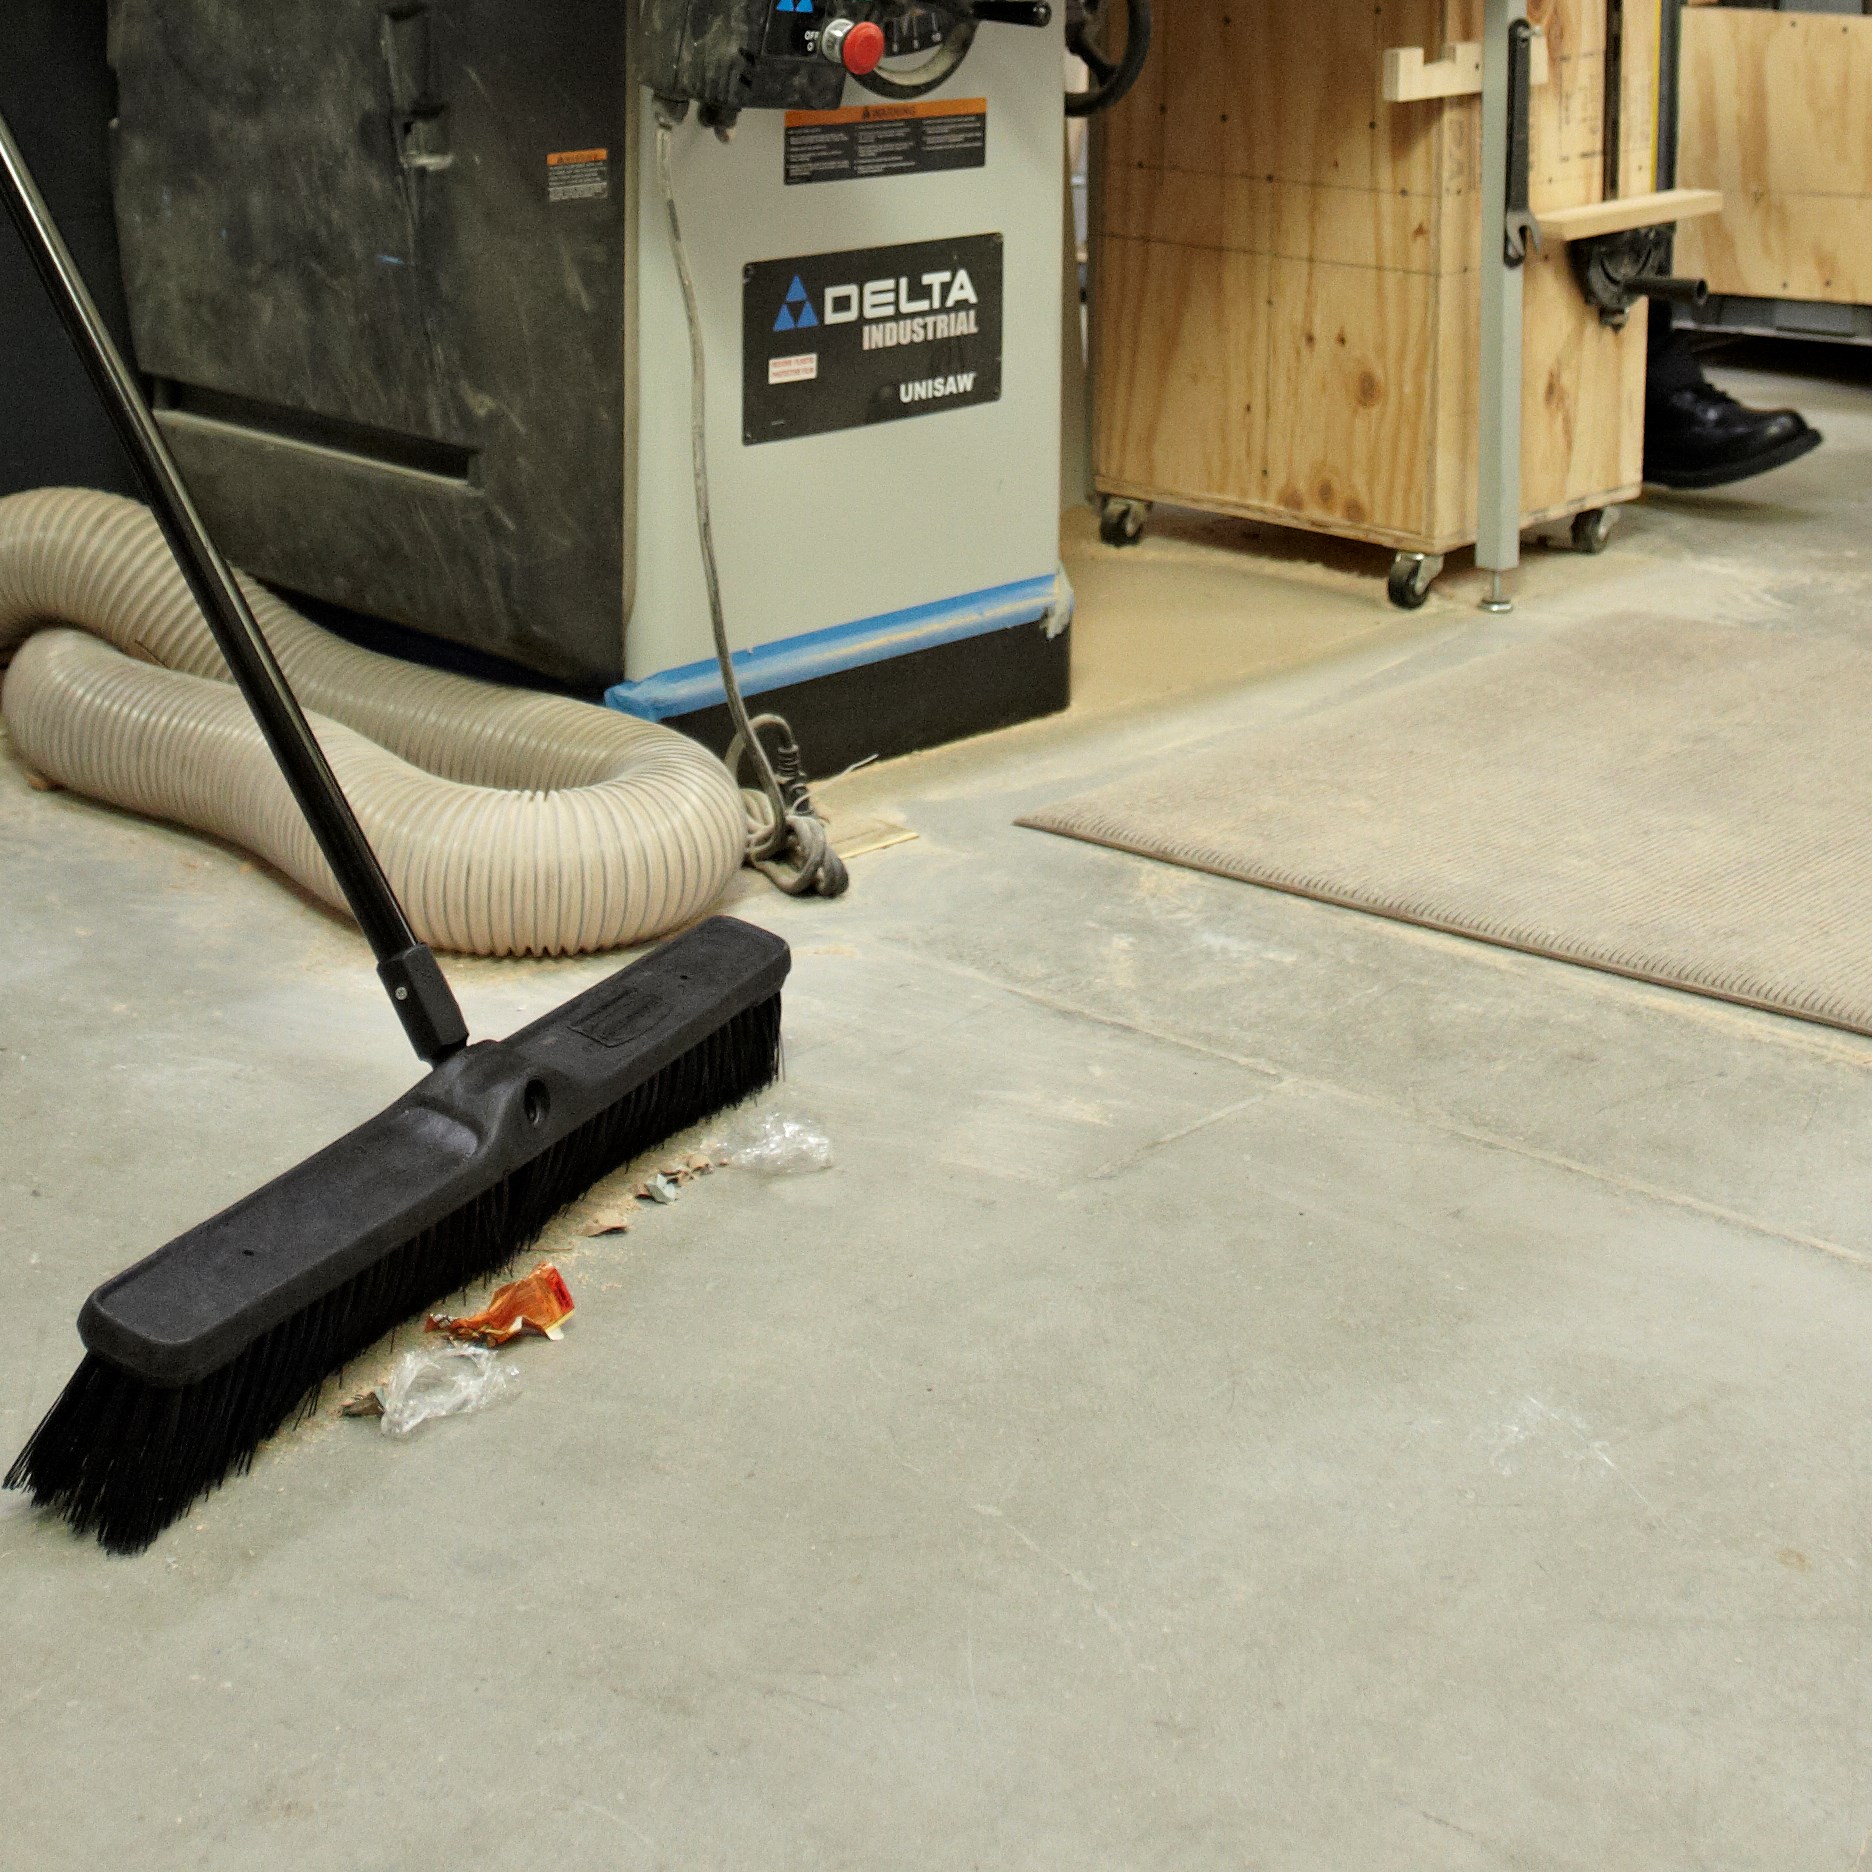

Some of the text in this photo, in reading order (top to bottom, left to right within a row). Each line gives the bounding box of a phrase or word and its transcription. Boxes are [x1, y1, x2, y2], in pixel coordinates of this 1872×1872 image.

[804, 30, 820, 40] OFF
[824, 268, 978, 325] DELTA
[862, 309, 978, 350] INDUSTRIAL
[899, 372, 976, 403] UNISAW
